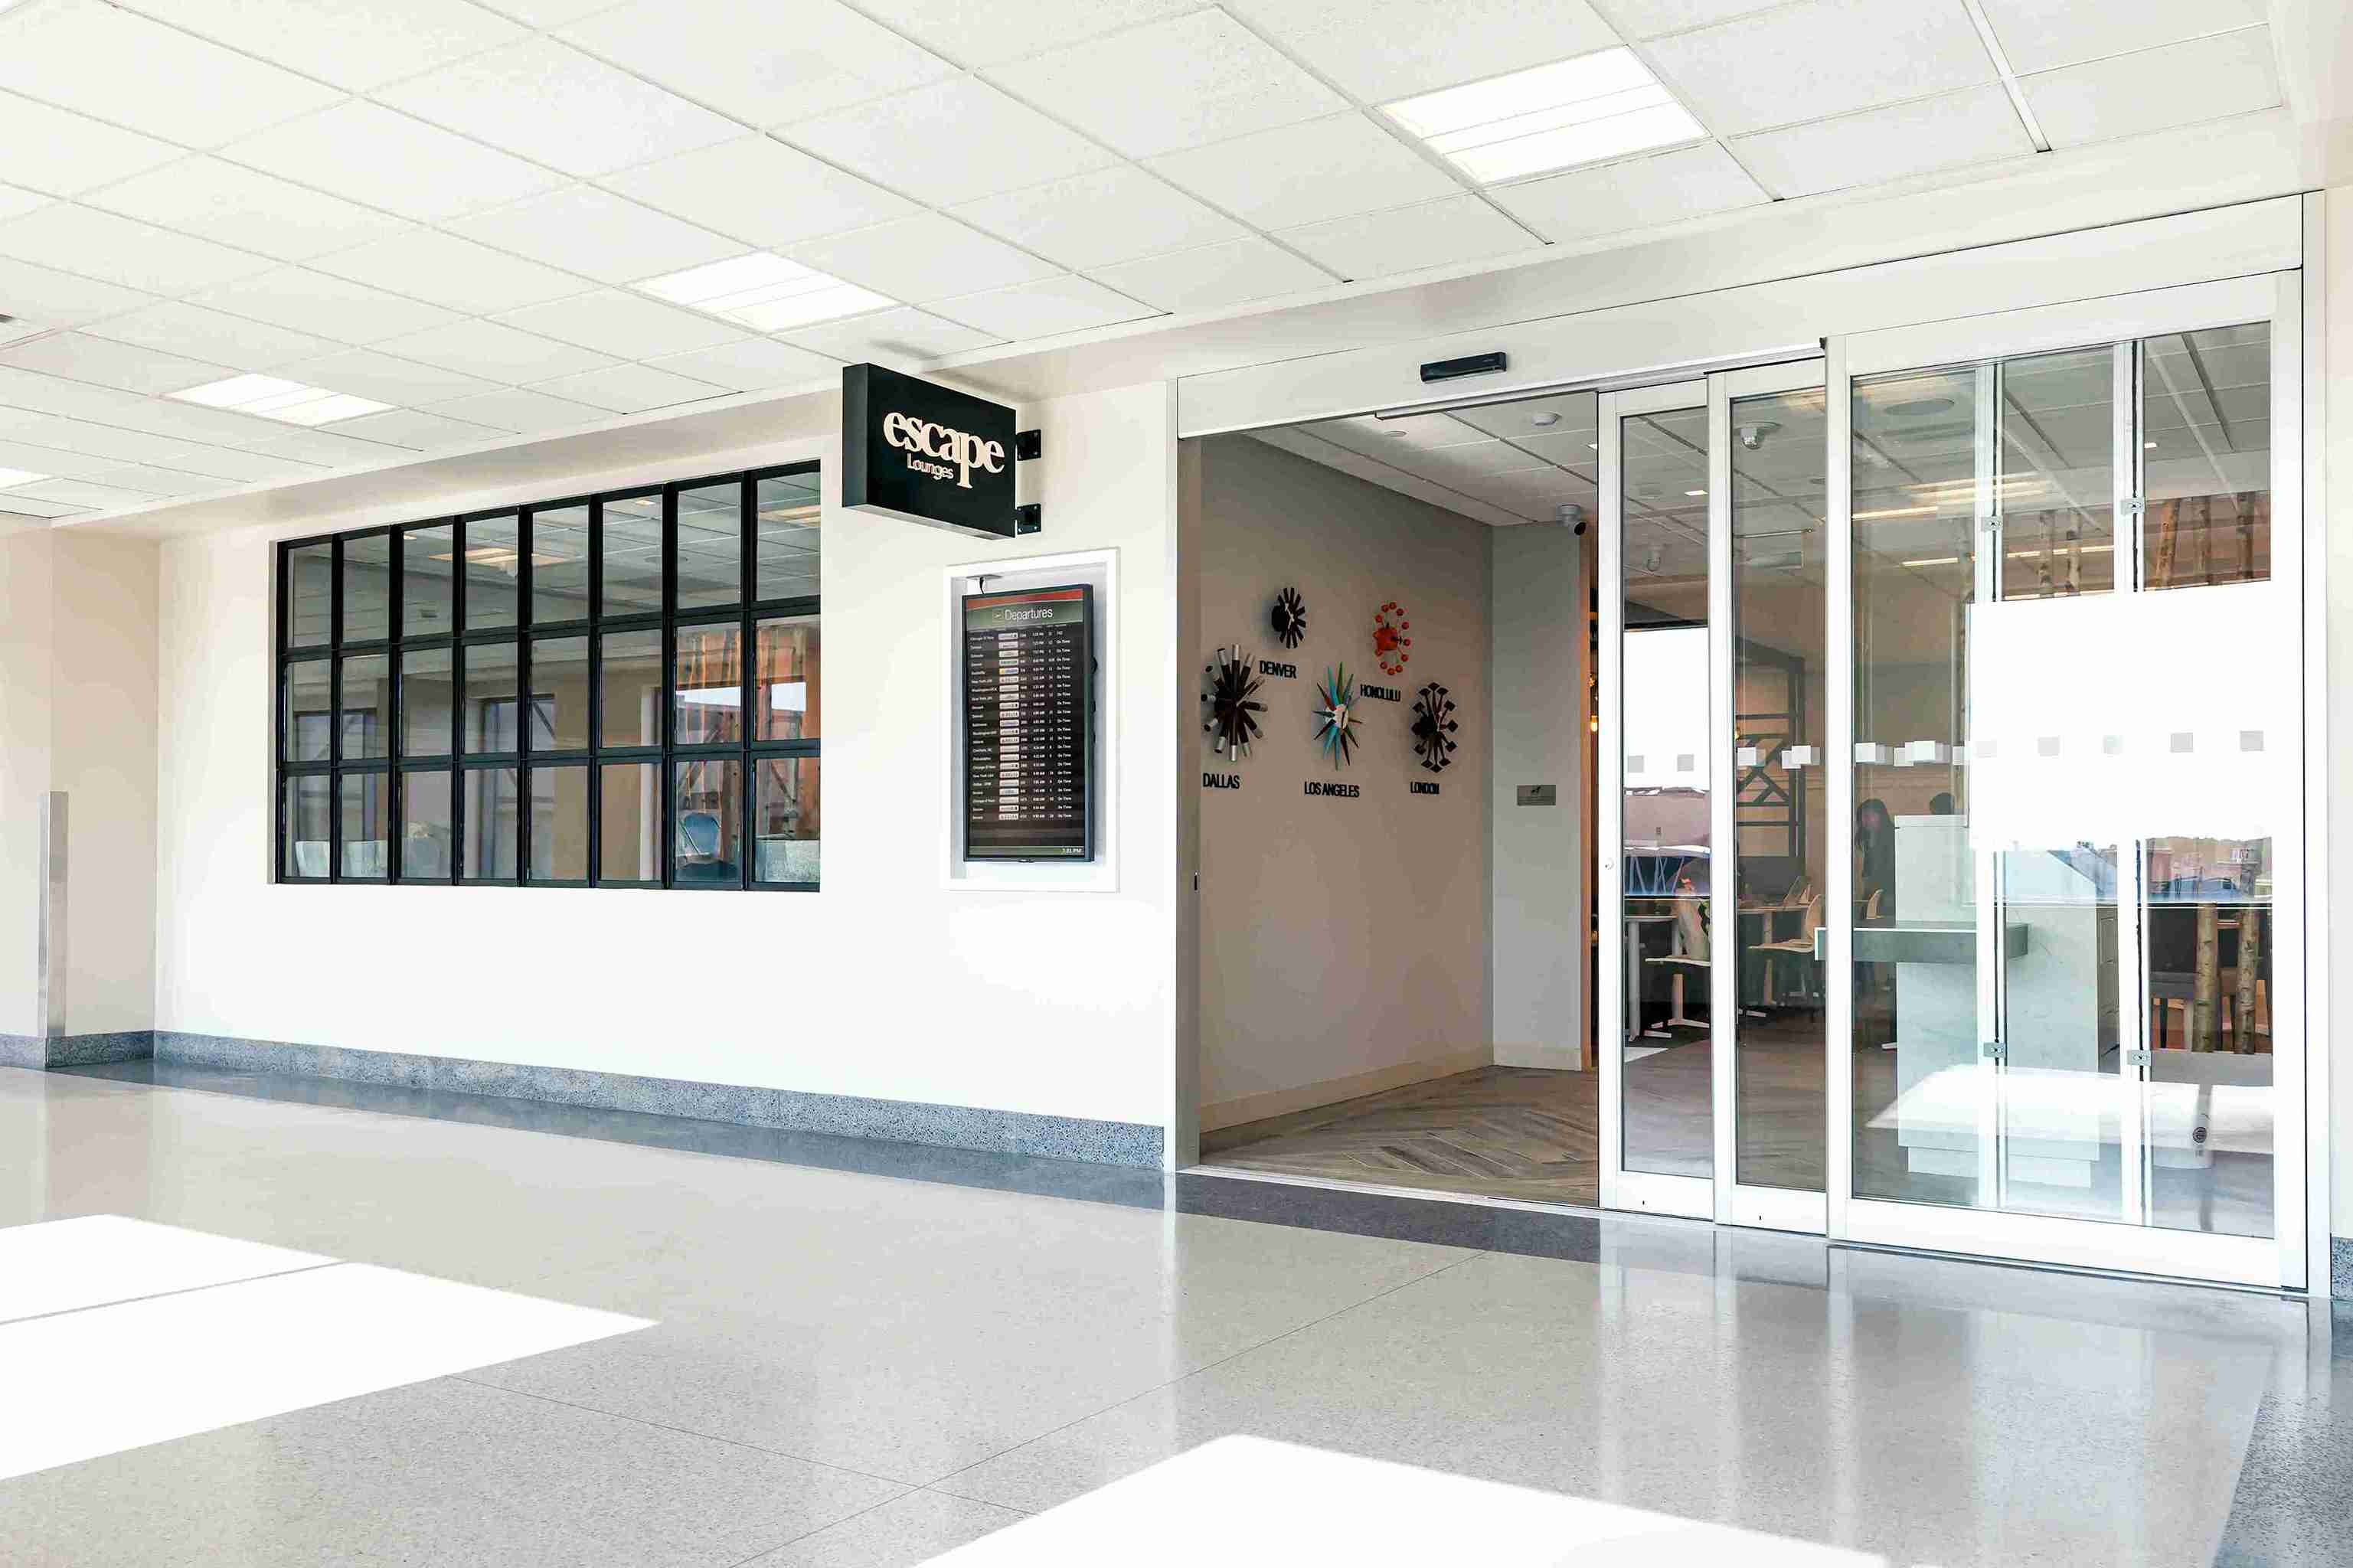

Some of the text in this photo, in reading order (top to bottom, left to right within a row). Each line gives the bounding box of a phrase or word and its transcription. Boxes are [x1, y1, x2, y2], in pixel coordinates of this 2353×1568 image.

[883, 412, 1005, 488] escape
[907, 452, 954, 480] Lounges
[1005, 608, 1053, 621] Departures
[1259, 660, 1297, 679] DENVER
[1360, 684, 1401, 702] HONOLULU
[1202, 773, 1240, 789] DALLAS
[1304, 781, 1360, 797] LOS ANGELES
[1410, 781, 1440, 795] LONDON
